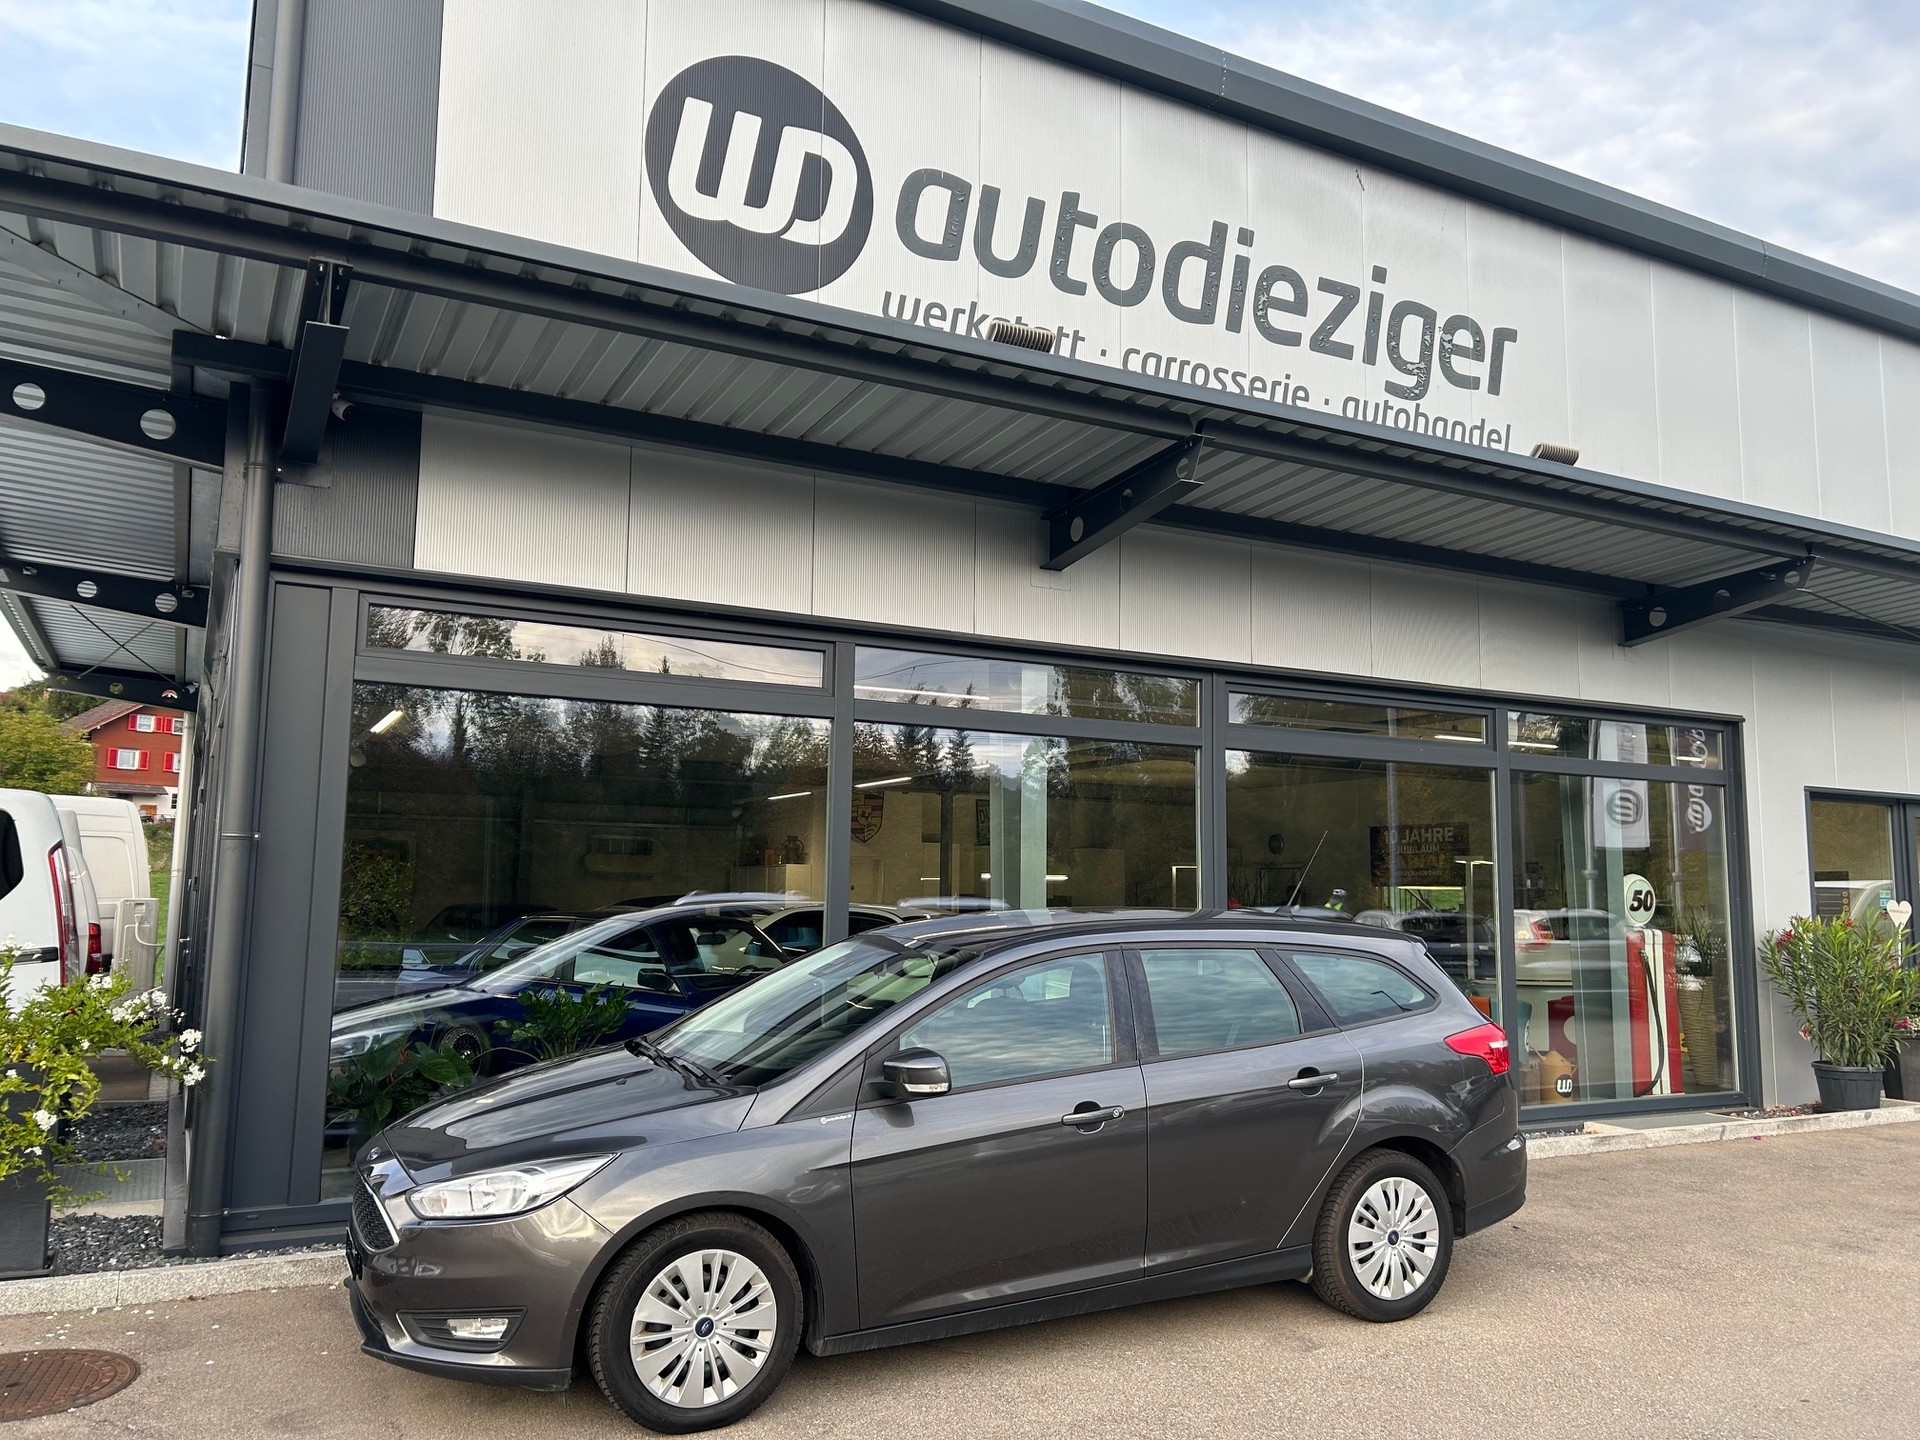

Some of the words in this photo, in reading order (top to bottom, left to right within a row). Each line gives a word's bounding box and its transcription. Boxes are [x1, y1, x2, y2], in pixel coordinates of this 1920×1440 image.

[895, 167, 1518, 401] autodieziger
[882, 290, 1086, 359] werktt
[1122, 347, 1310, 408] carrosserie
[1341, 396, 1512, 452] autohandel
[1401, 827, 1455, 844] JAHRE
[1629, 890, 1654, 912] 50
